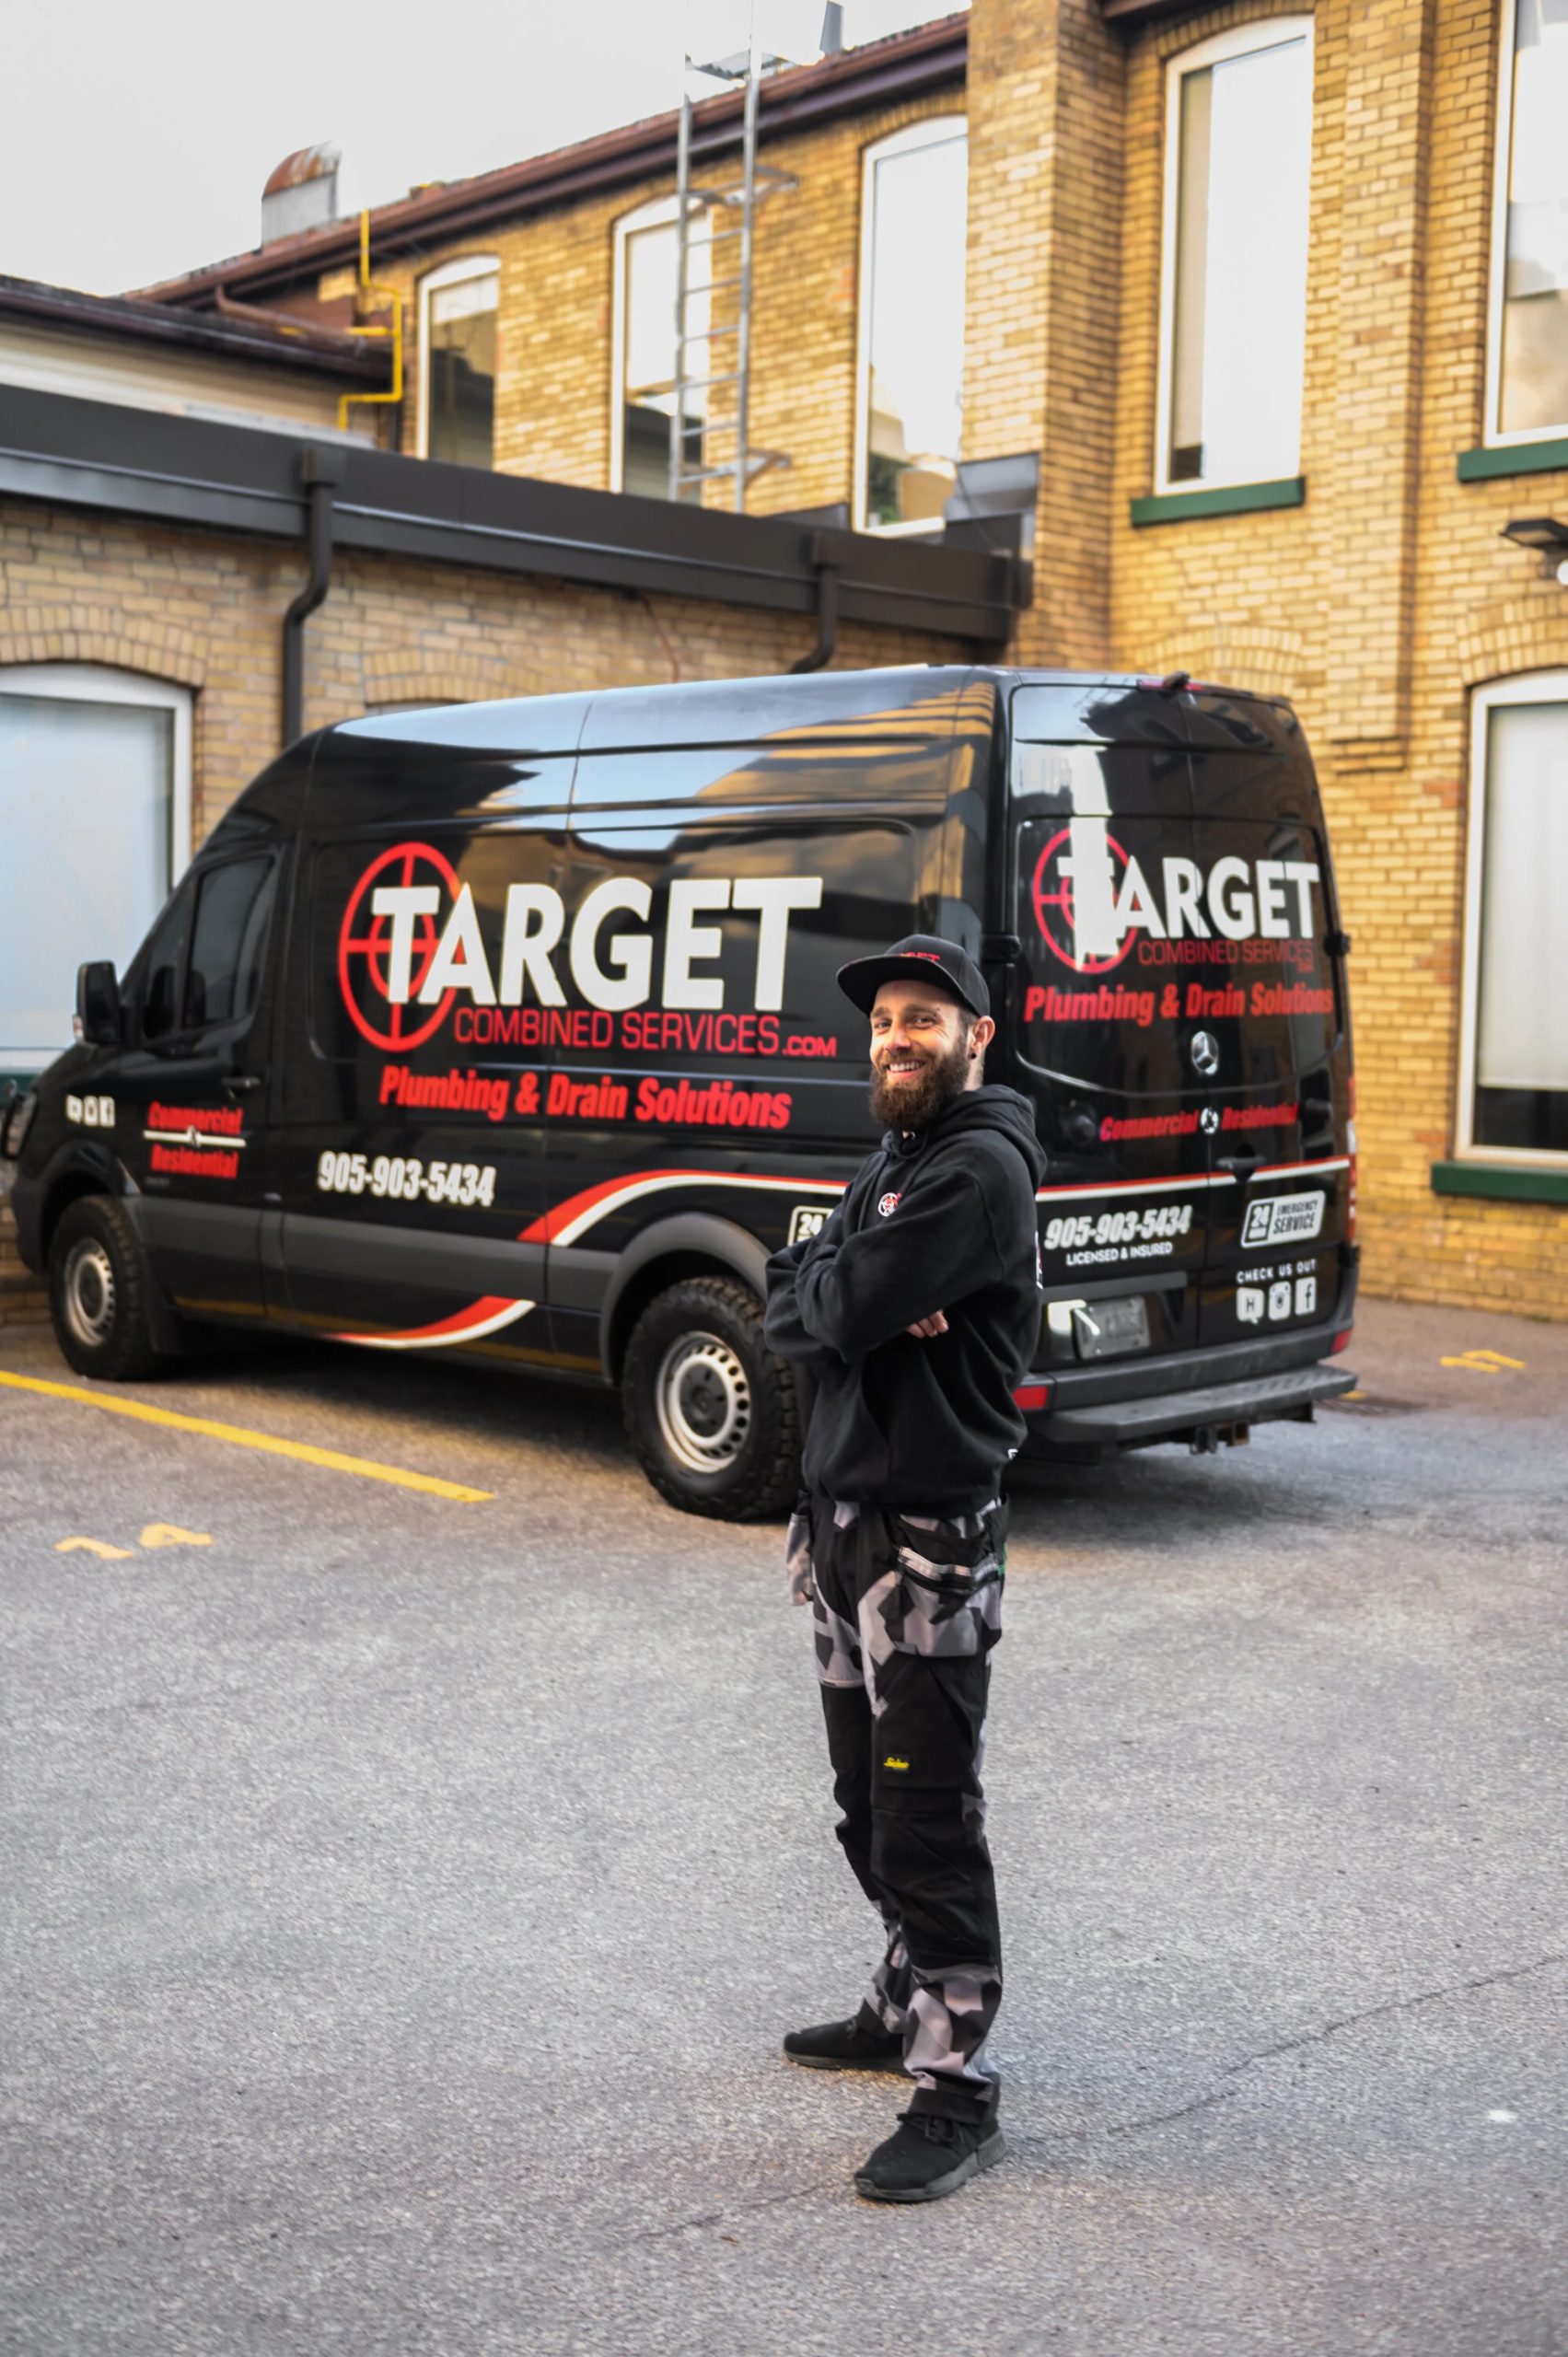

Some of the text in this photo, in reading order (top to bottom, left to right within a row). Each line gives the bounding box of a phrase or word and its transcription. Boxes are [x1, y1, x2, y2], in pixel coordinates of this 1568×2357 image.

[1056, 854, 1319, 941] TARGET
[372, 877, 823, 1012] TARGET
[1137, 938, 1315, 966] COMBINED SERVICES
[1024, 981, 1334, 1027] Plumbing & Drain Solutions
[454, 1007, 614, 1049] COMBINED
[378, 1064, 793, 1130] Plumbing & Drain Solutions
[1100, 1109, 1199, 1142] Commercial
[318, 1151, 497, 1207] 905-903-5434
[1043, 1204, 1193, 1250] 905-903-5434
[1272, 1212, 1316, 1235] SERVICE
[1065, 1241, 1174, 1267] LICENSED & INSURED
[1237, 1258, 1317, 1284] CHECK US OUT
